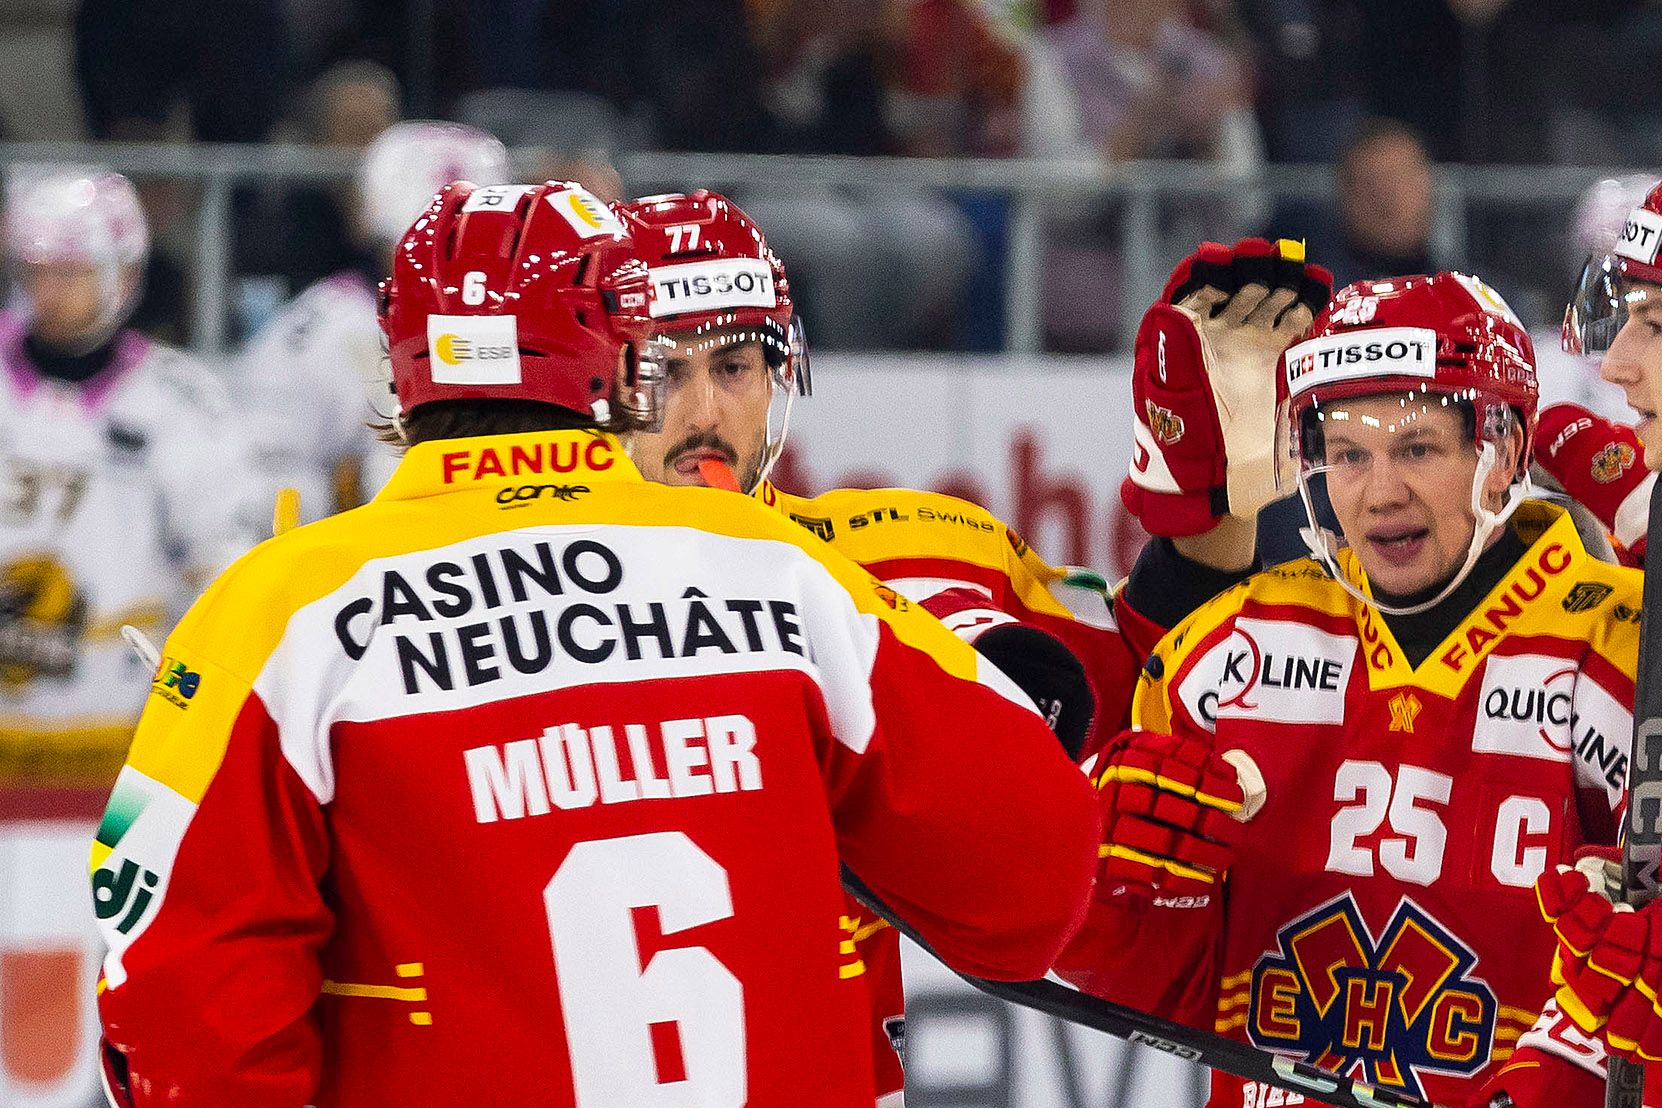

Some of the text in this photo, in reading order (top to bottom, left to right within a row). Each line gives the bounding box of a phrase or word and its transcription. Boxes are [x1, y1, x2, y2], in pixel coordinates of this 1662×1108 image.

[665, 224, 700, 254] 77
[462, 271, 488, 306] 6
[660, 271, 769, 300] TISSOT
[478, 346, 514, 361] ESB
[1318, 341, 1428, 370] TISSOT
[442, 438, 615, 485] FANUC
[849, 506, 910, 531] STL
[334, 538, 624, 662] CASINO
[1440, 541, 1573, 673] FANUC
[463, 713, 764, 825] MÜLLER
[1325, 758, 1454, 888] 25
[1490, 795, 1551, 888] C
